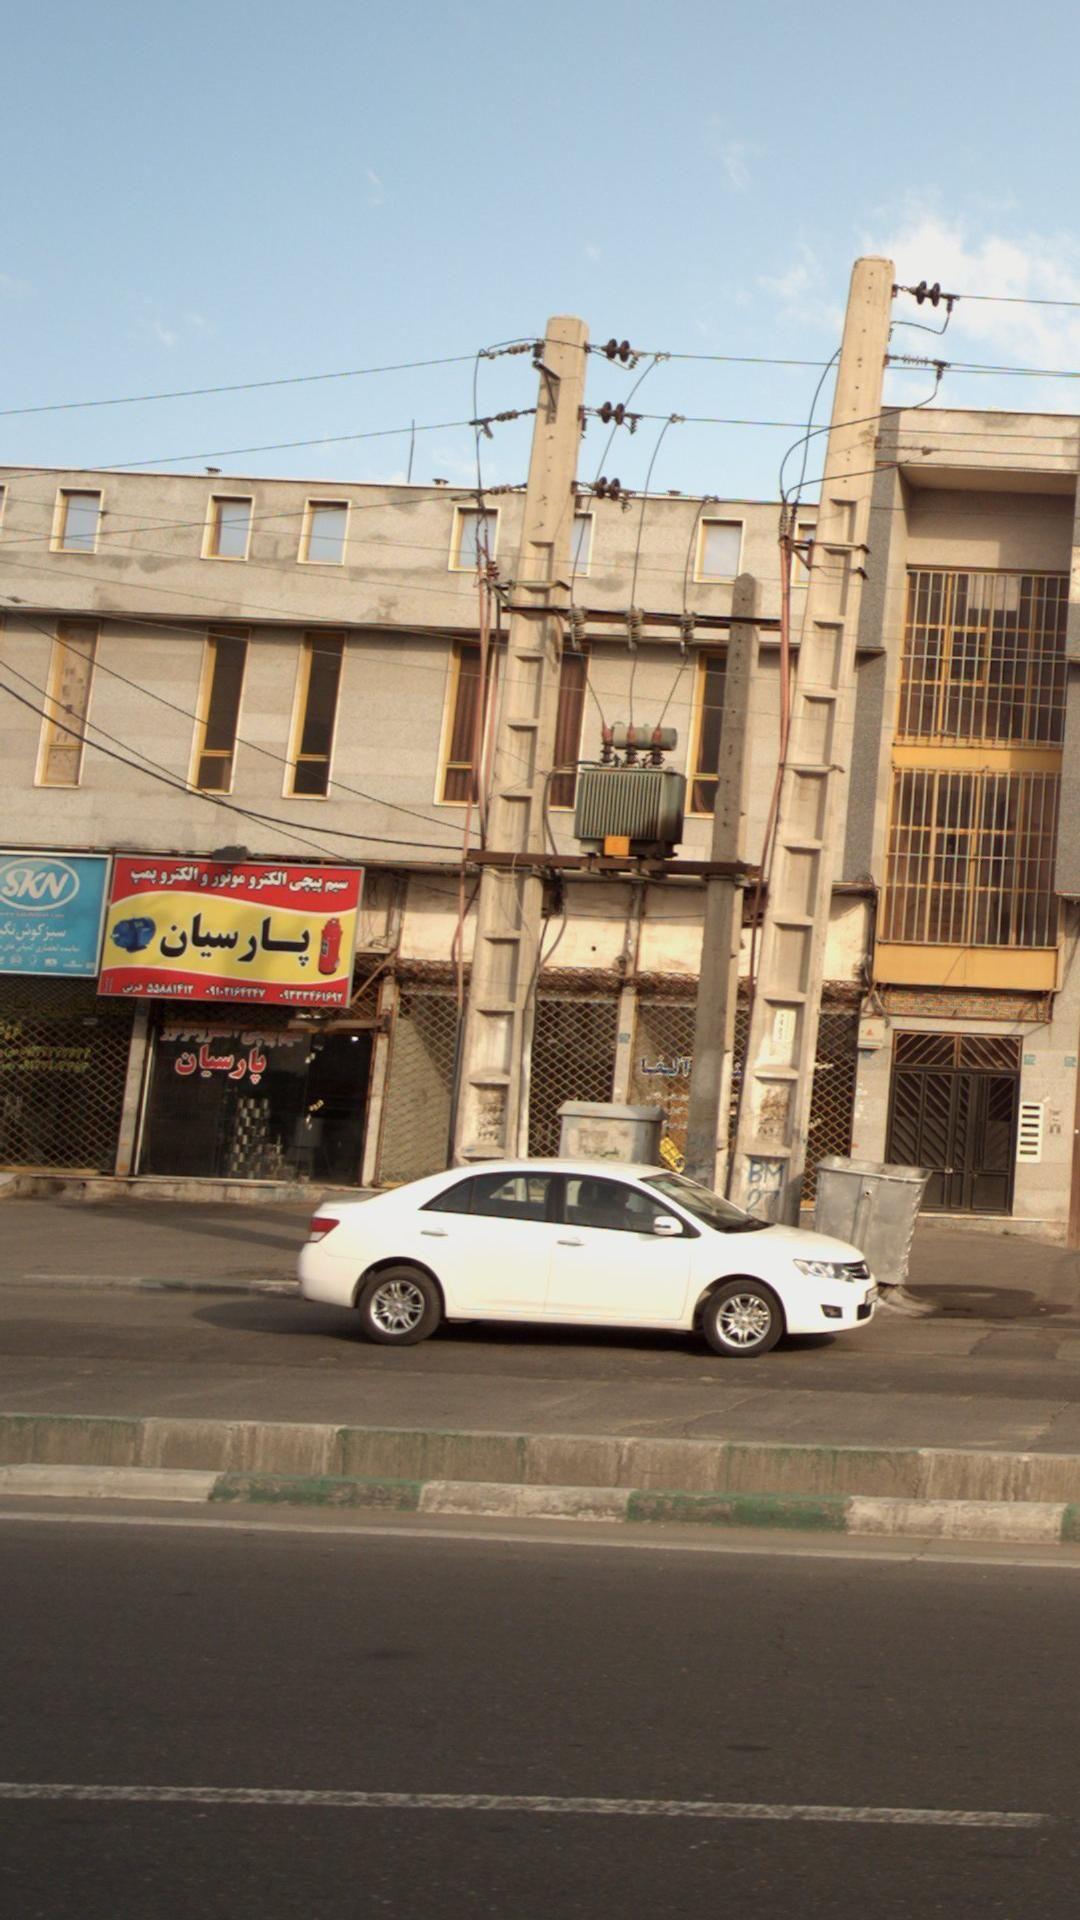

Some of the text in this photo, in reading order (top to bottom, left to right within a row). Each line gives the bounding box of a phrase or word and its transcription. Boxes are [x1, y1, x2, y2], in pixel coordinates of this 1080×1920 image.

[1, 868, 69, 899] SKN
[131, 866, 348, 893] سیم پیچی الکترو موتور و الکترو پمپ
[160, 912, 311, 967] پارسیان
[175, 1044, 267, 1085] پارسیان
